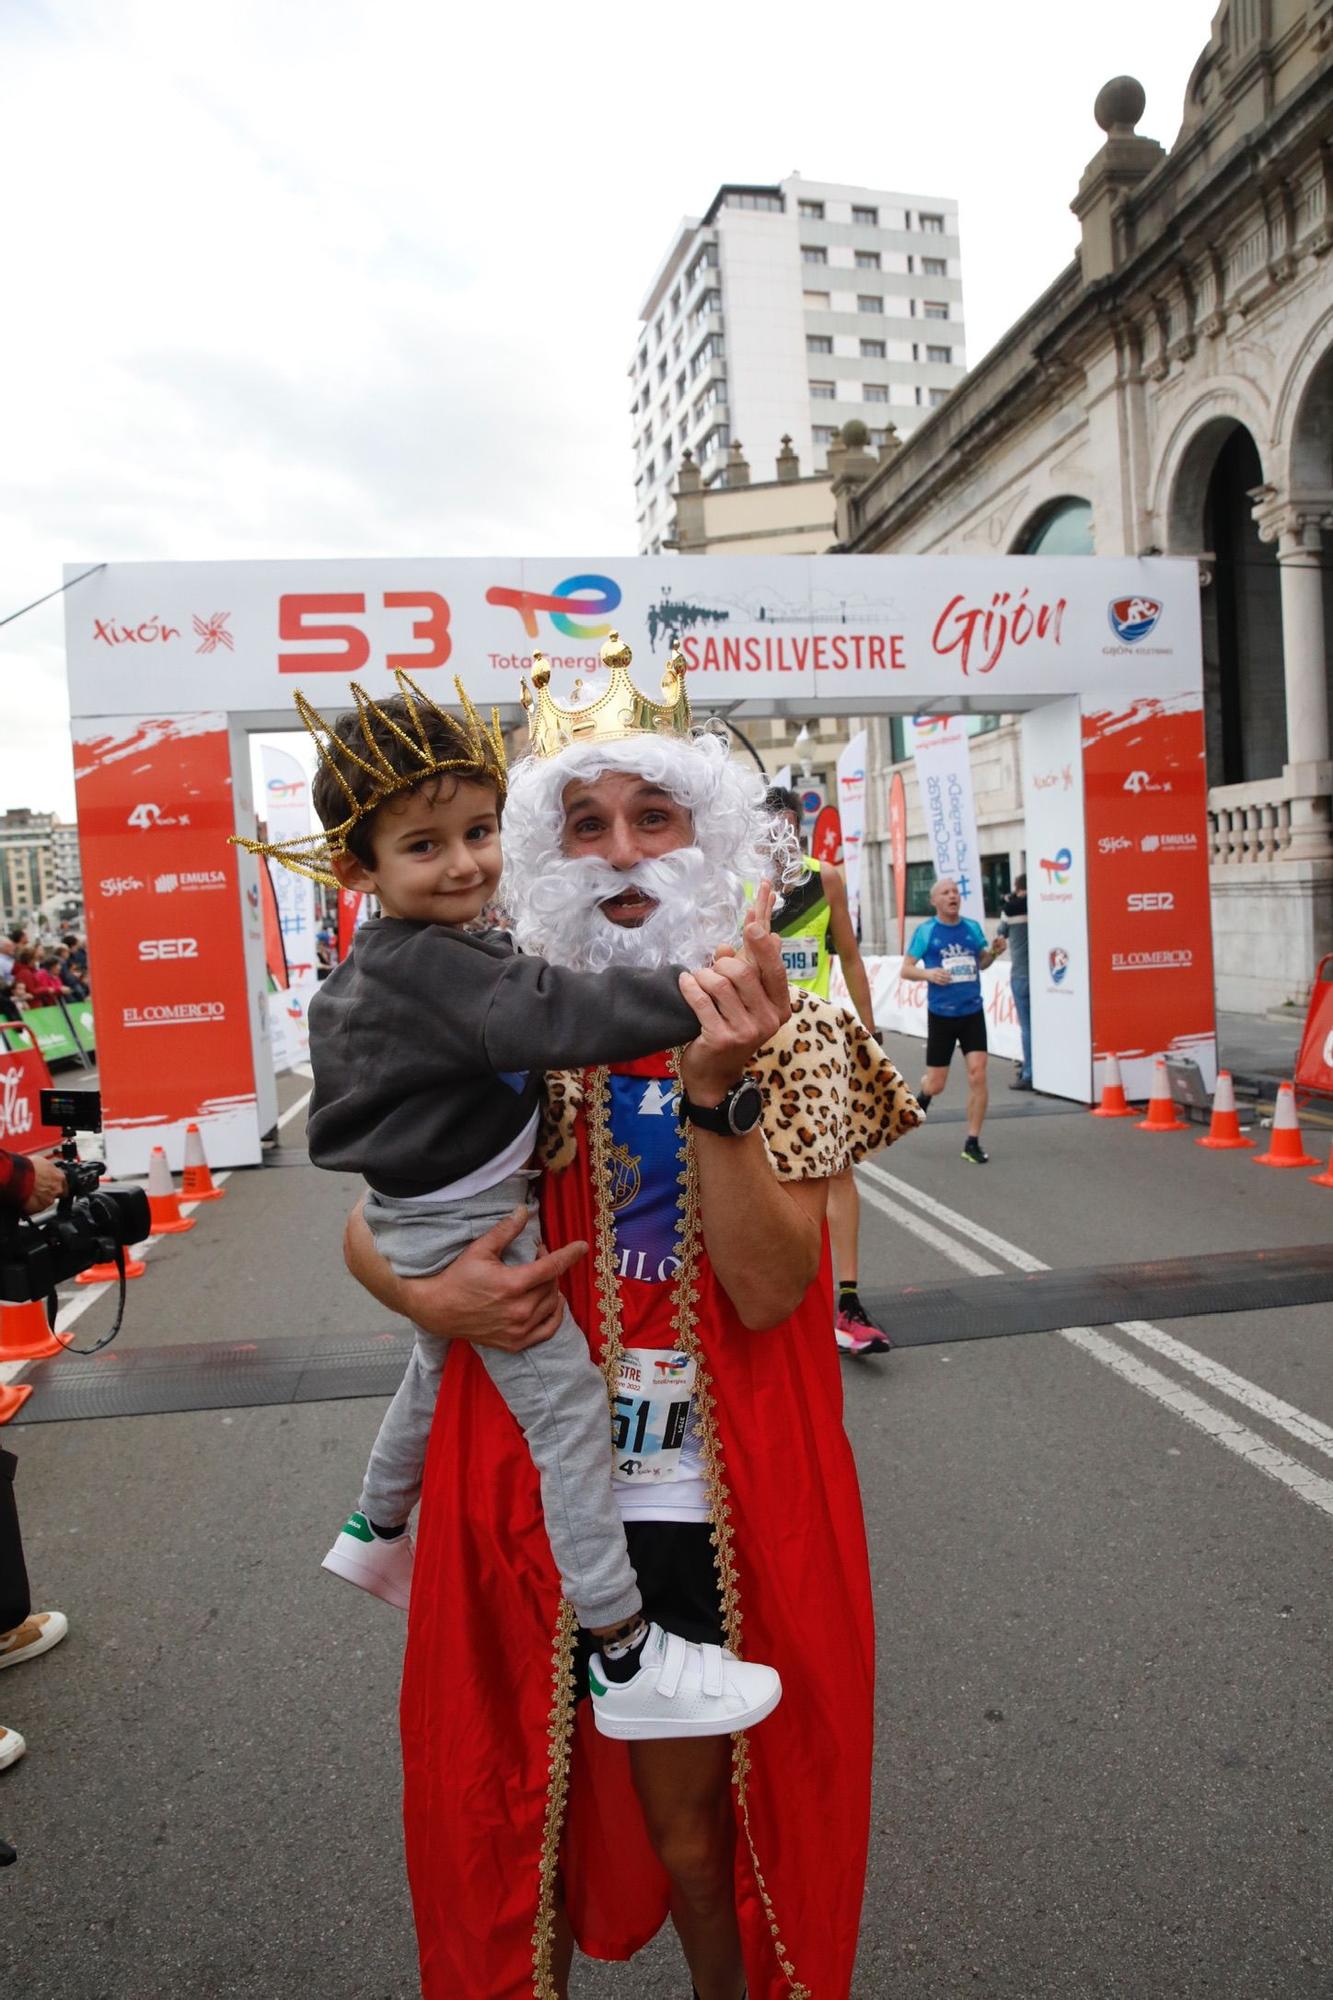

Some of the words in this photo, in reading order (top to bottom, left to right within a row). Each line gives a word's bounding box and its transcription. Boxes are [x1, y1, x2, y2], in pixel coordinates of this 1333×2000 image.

[93, 615, 181, 647] Xixón
[278, 590, 452, 674] 53
[932, 587, 1067, 677] Gijón
[488, 652, 603, 674] Totanergi
[682, 635, 906, 672] SANSILVESTRE
[1161, 832, 1198, 845] EMULSA
[180, 871, 226, 884] EMULSA
[1127, 892, 1175, 912] SER
[138, 937, 199, 961] SER
[1112, 953, 1127, 966] EL
[1128, 950, 1192, 965] COMERCIO
[123, 1007, 142, 1021] EL
[143, 1002, 225, 1021] COMERCIO
[618, 1249, 683, 1282] ILO
